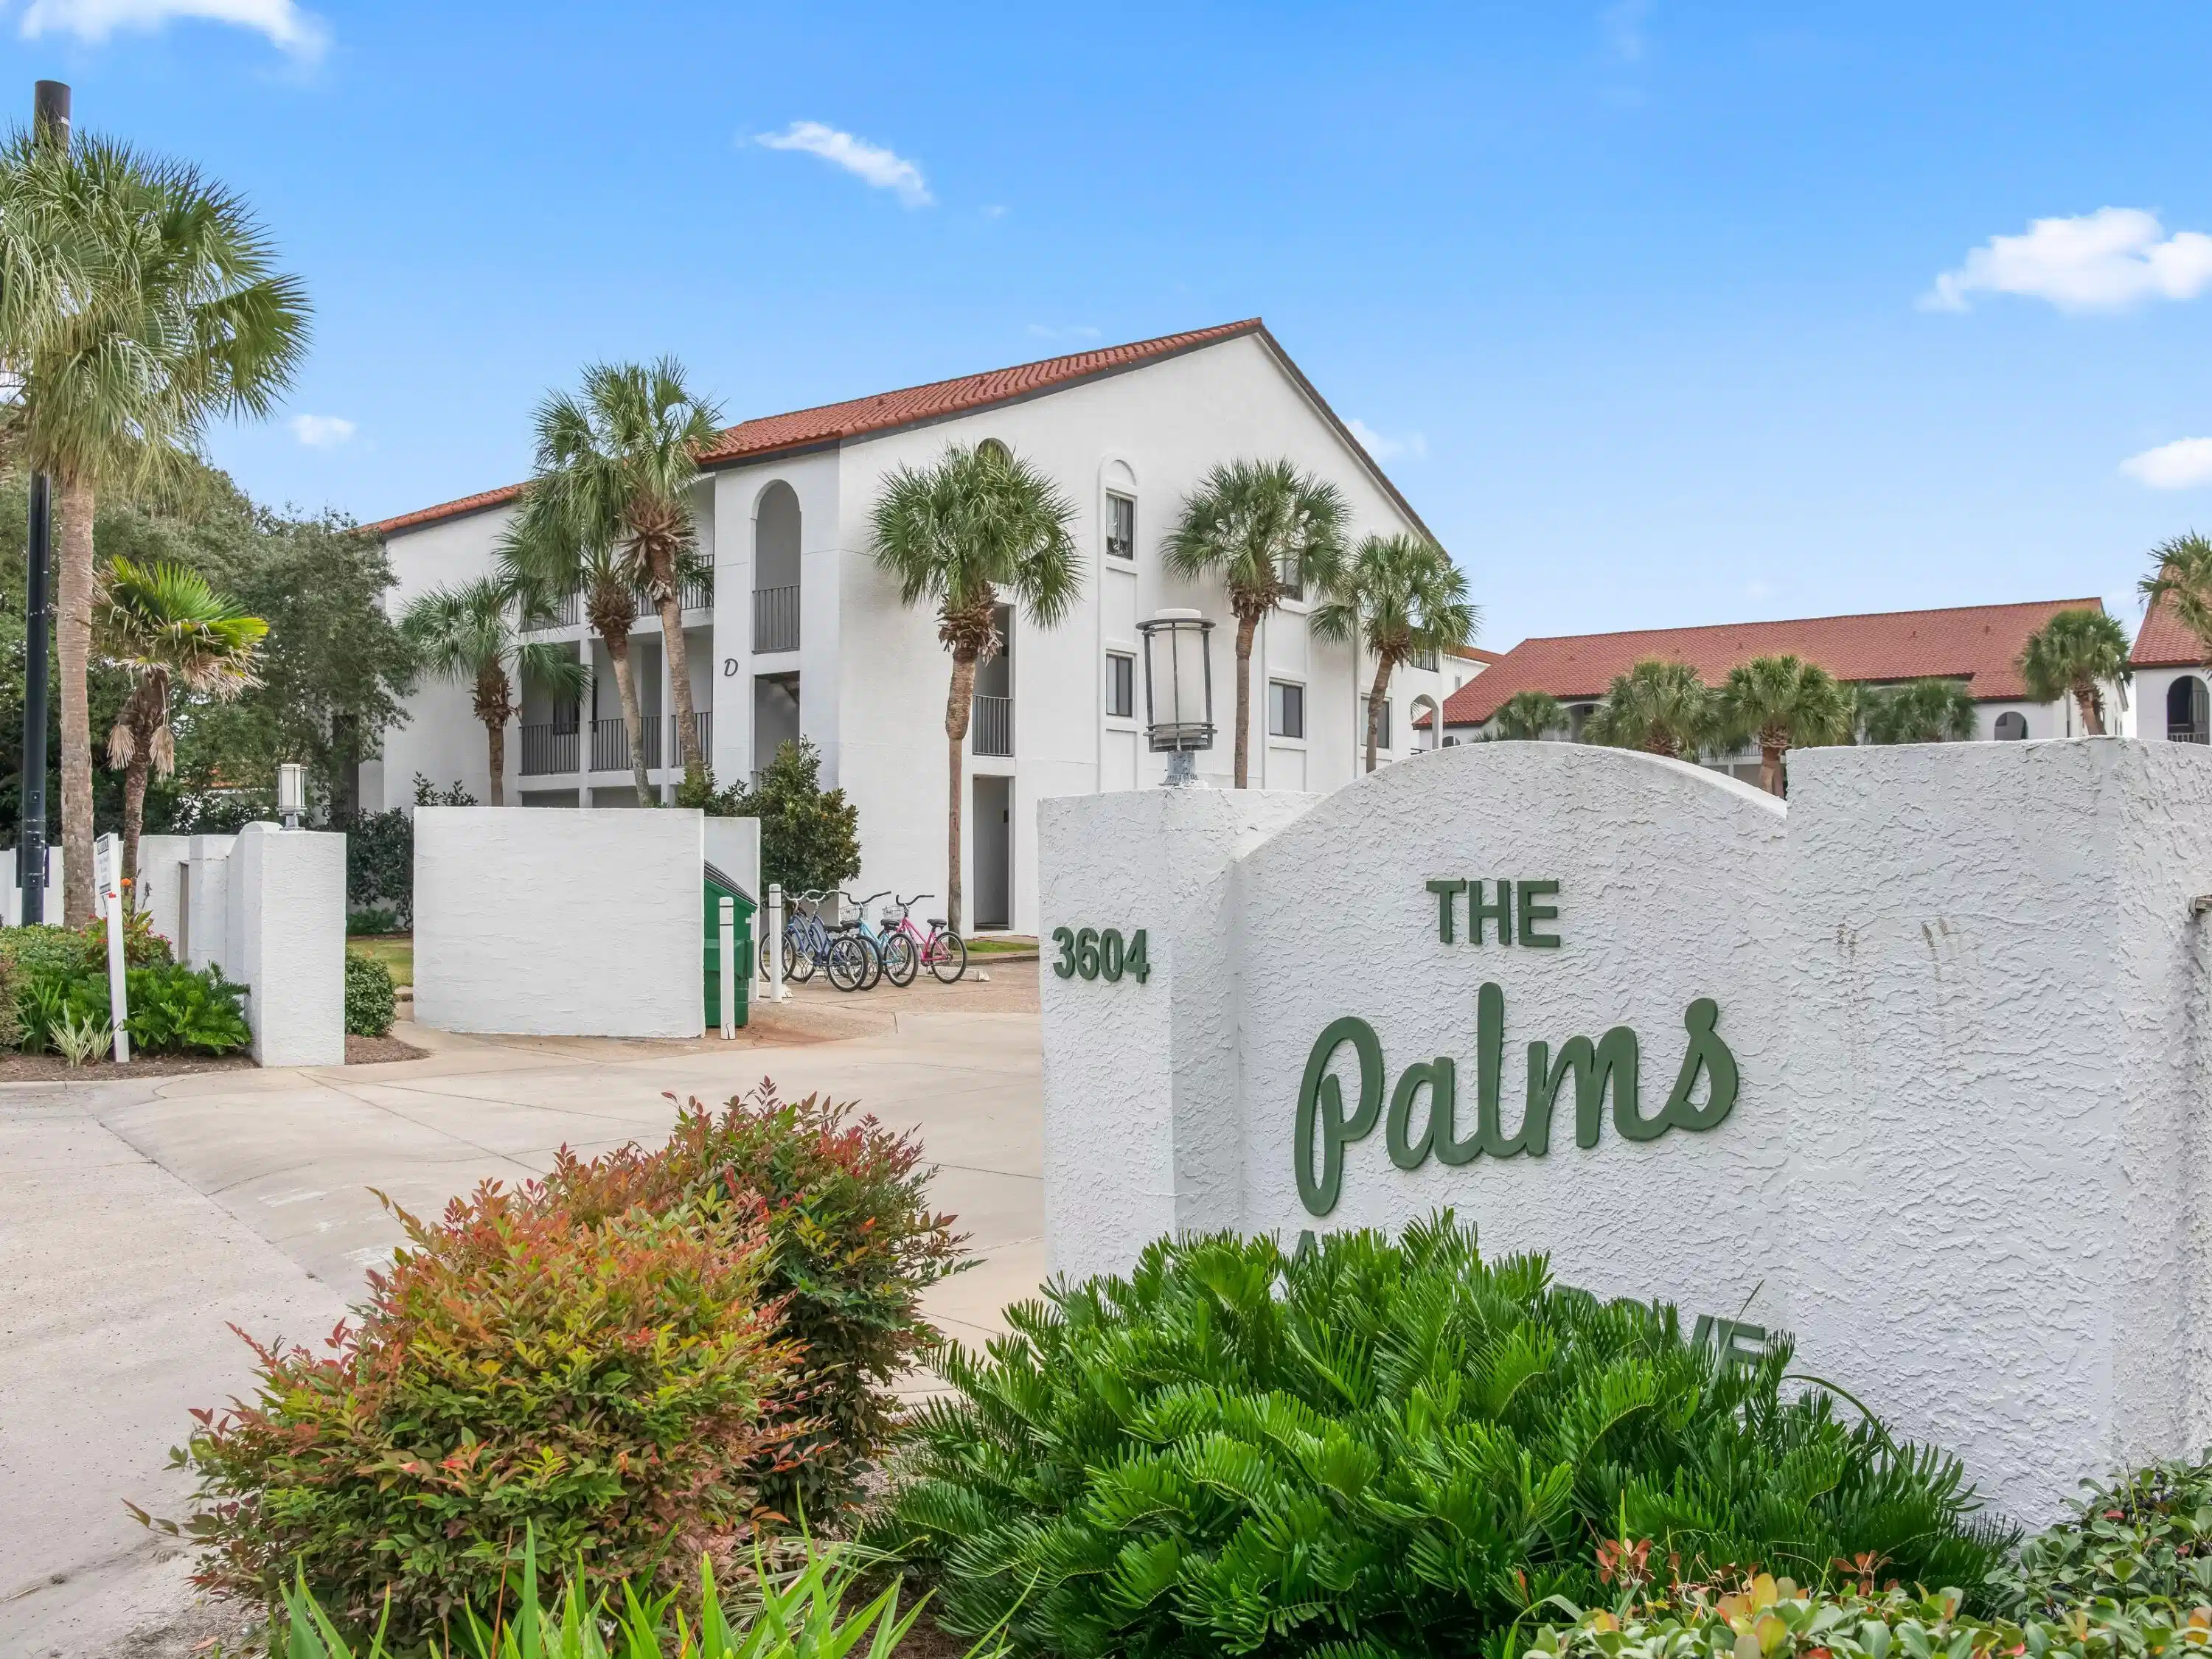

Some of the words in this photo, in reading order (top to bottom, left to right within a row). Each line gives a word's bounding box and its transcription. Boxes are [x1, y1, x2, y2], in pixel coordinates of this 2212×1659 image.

[723, 658, 739, 677] D
[1425, 877, 1561, 948] THE
[1051, 926, 1151, 984] 3604
[1294, 981, 1739, 1217] Palms
